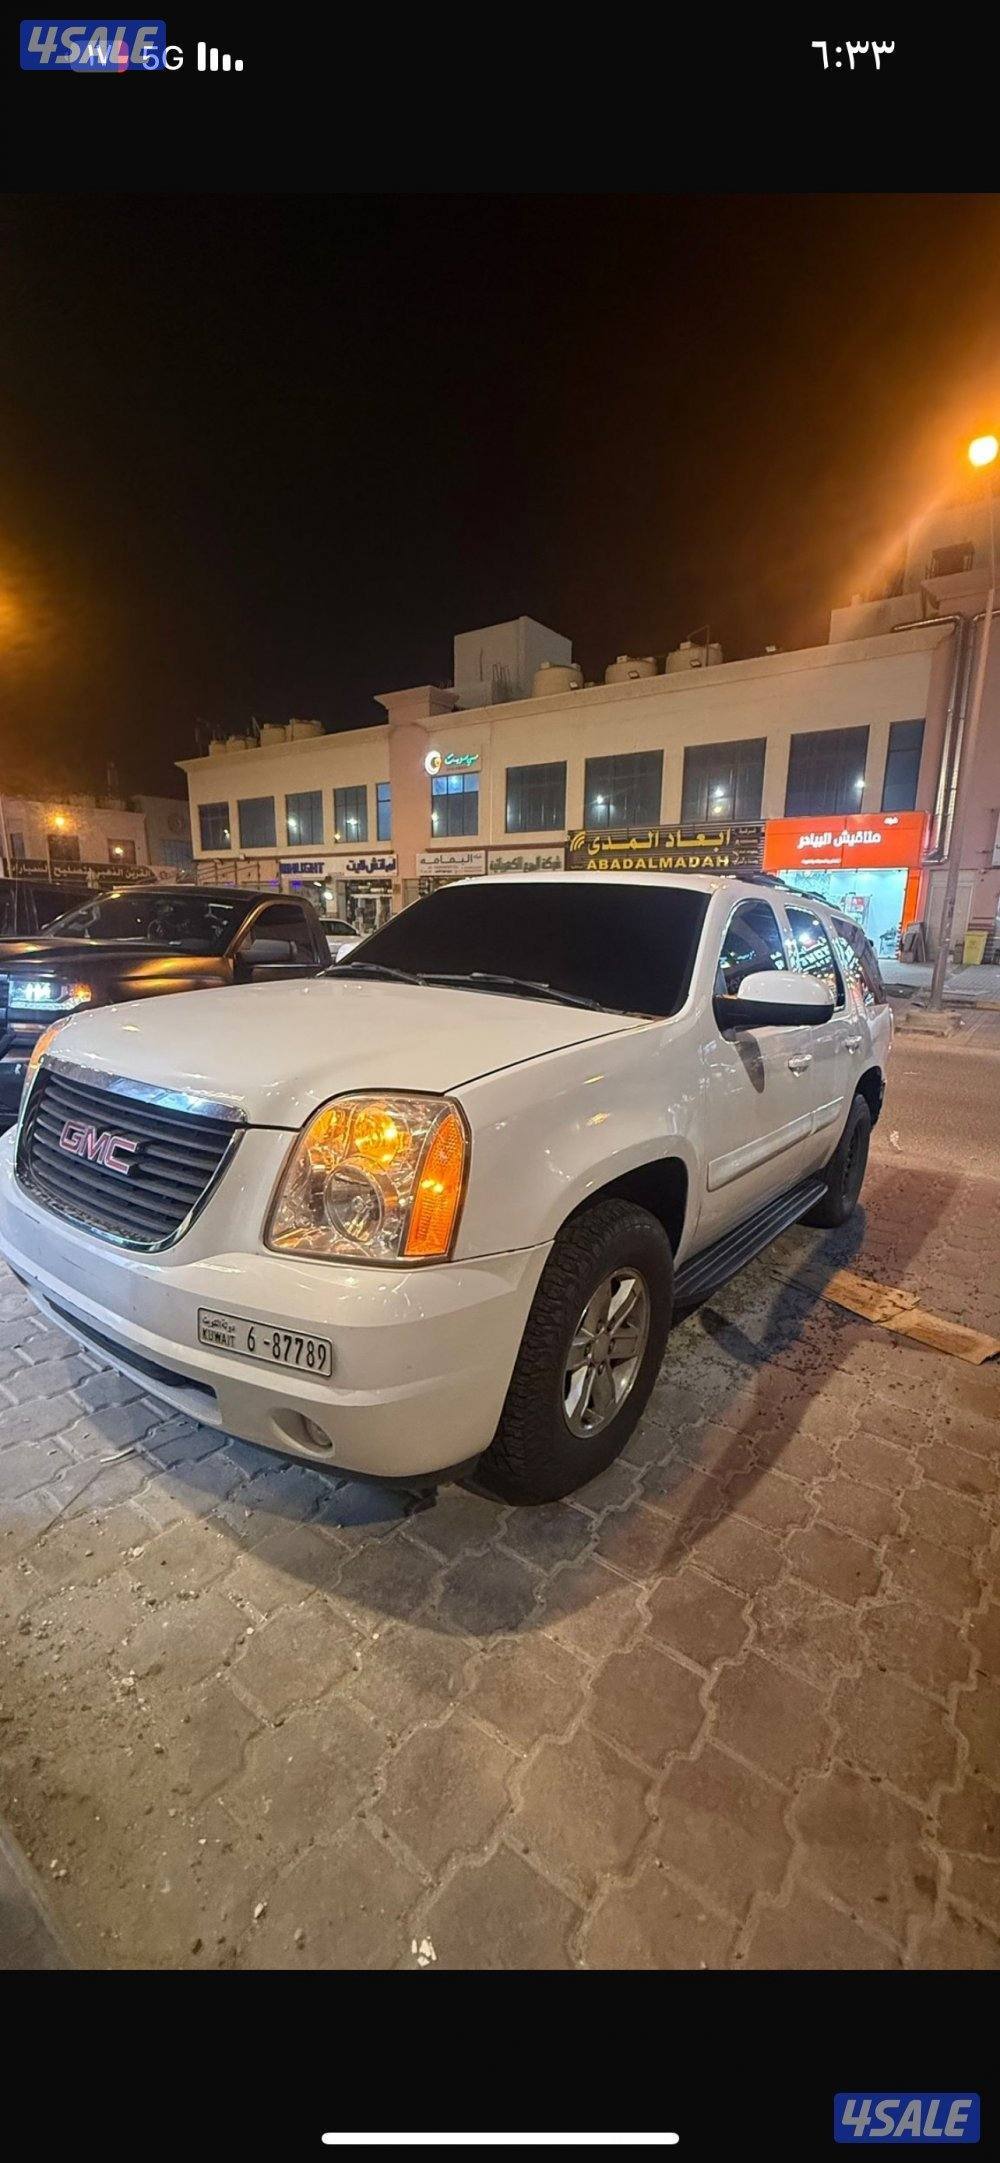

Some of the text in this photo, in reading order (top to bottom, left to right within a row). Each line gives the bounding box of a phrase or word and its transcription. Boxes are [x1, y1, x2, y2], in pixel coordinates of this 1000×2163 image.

[586, 855, 730, 871] ABADALMADAH
[59, 1119, 140, 1175] GMC
[202, 1327, 236, 1347] KUWAIT
